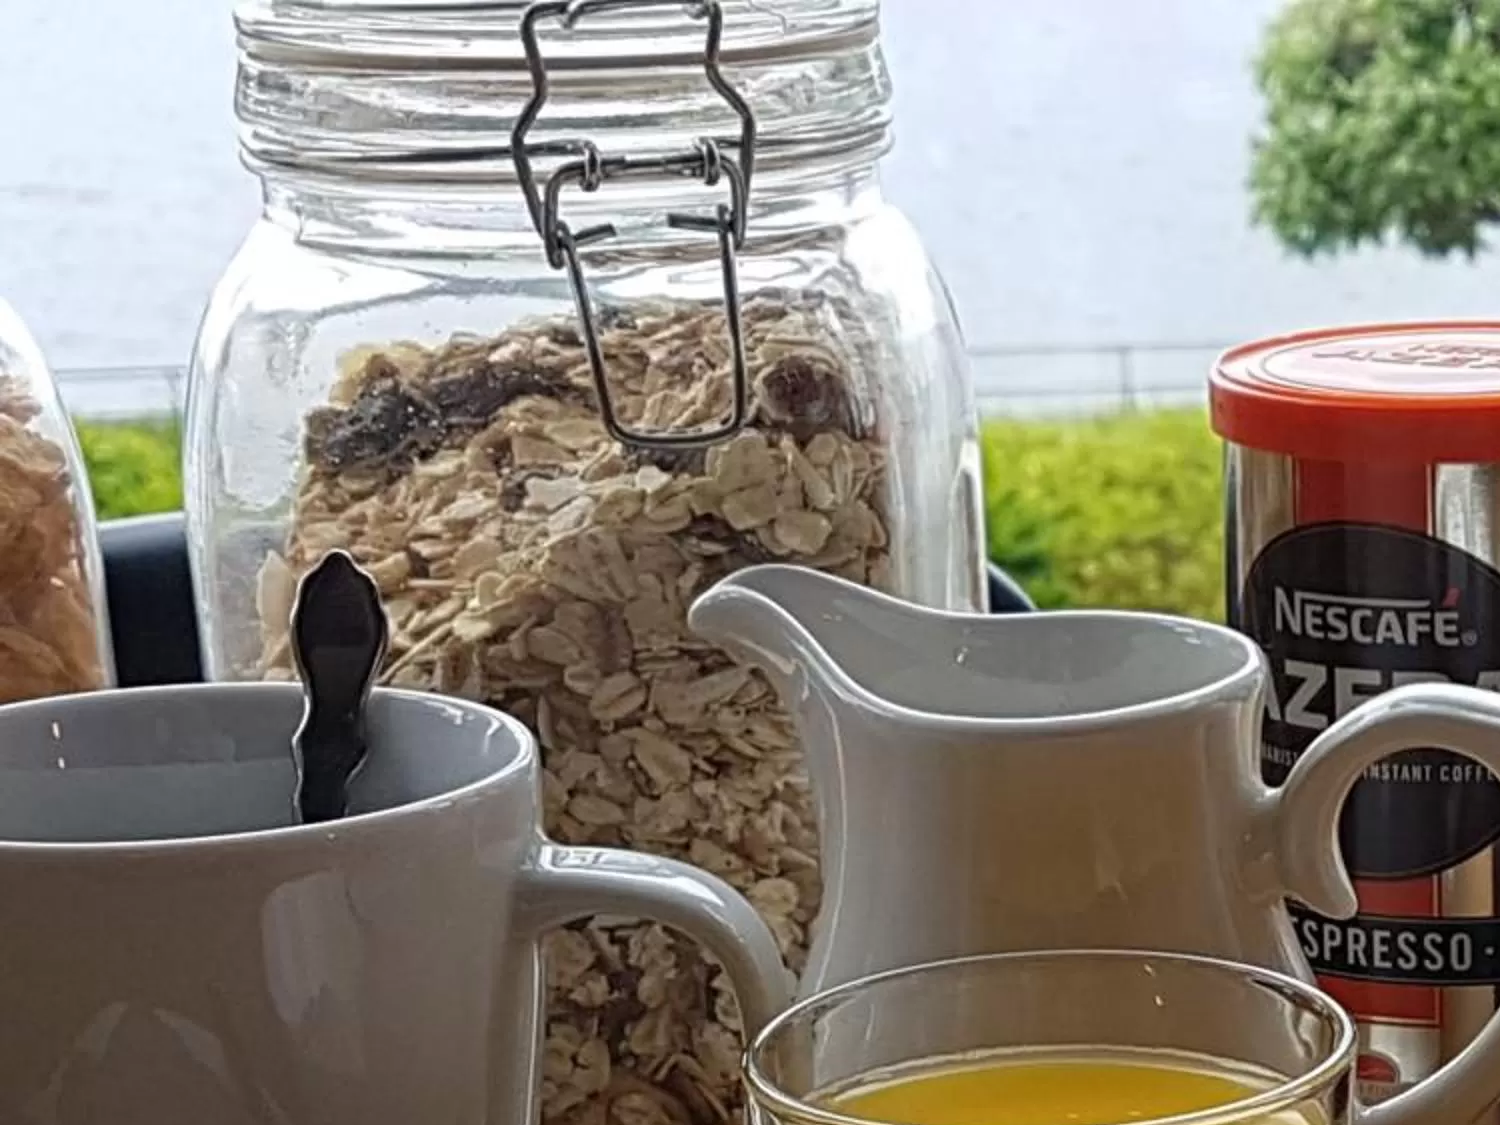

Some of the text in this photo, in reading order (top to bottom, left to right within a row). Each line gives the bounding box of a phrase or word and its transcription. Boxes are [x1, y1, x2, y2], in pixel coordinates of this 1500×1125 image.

[1363, 764, 1496, 783] INSTANT COFFE
[1292, 917, 1472, 972] SPRESSO
